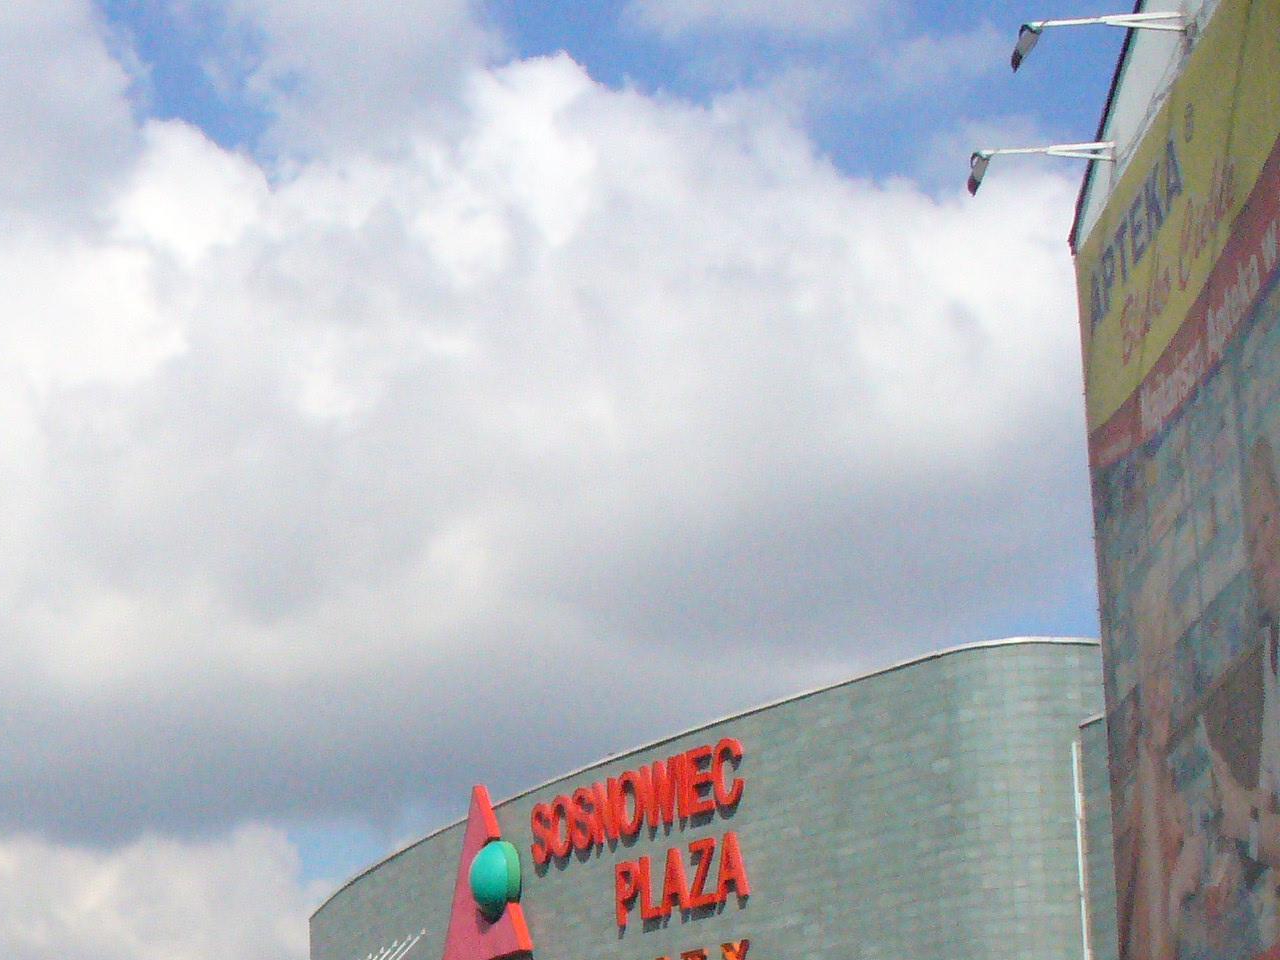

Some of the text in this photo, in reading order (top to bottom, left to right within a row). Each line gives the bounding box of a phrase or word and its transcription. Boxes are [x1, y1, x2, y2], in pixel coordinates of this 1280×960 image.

[1090, 138, 1184, 335] APTEKA
[530, 738, 745, 865] SOSNOWIEC
[615, 831, 751, 926] PLAZA
